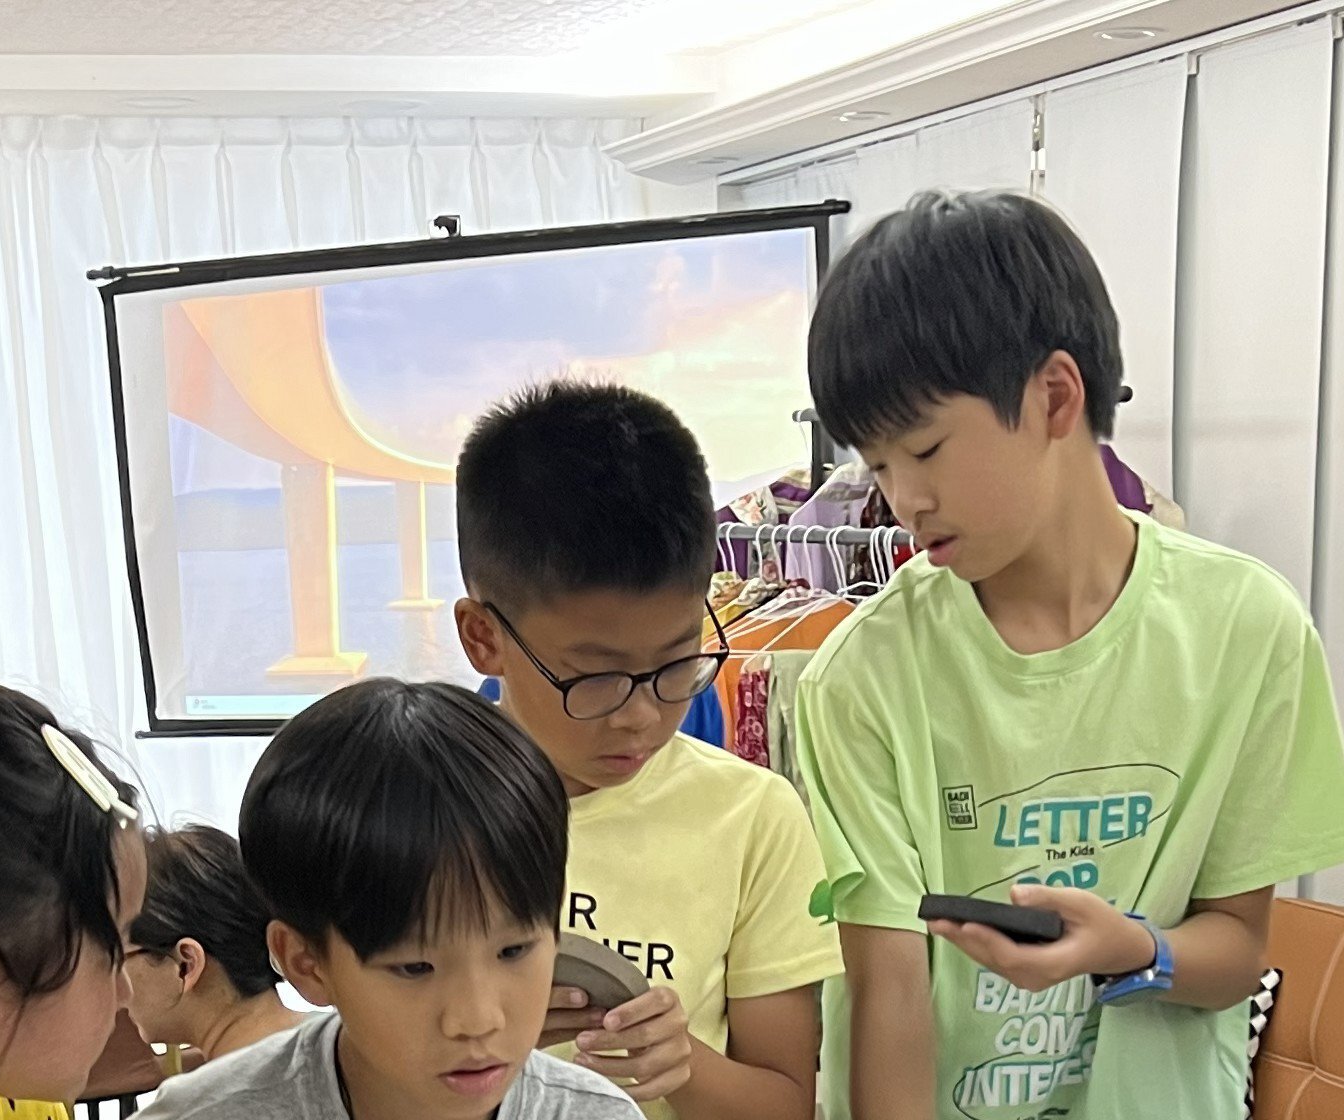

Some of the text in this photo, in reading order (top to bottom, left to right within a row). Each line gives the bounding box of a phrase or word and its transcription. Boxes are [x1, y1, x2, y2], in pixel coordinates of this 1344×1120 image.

[993, 794, 1153, 847] LETTER
[1045, 846, 1095, 860] The Kids
[1015, 861, 1099, 889] OP
